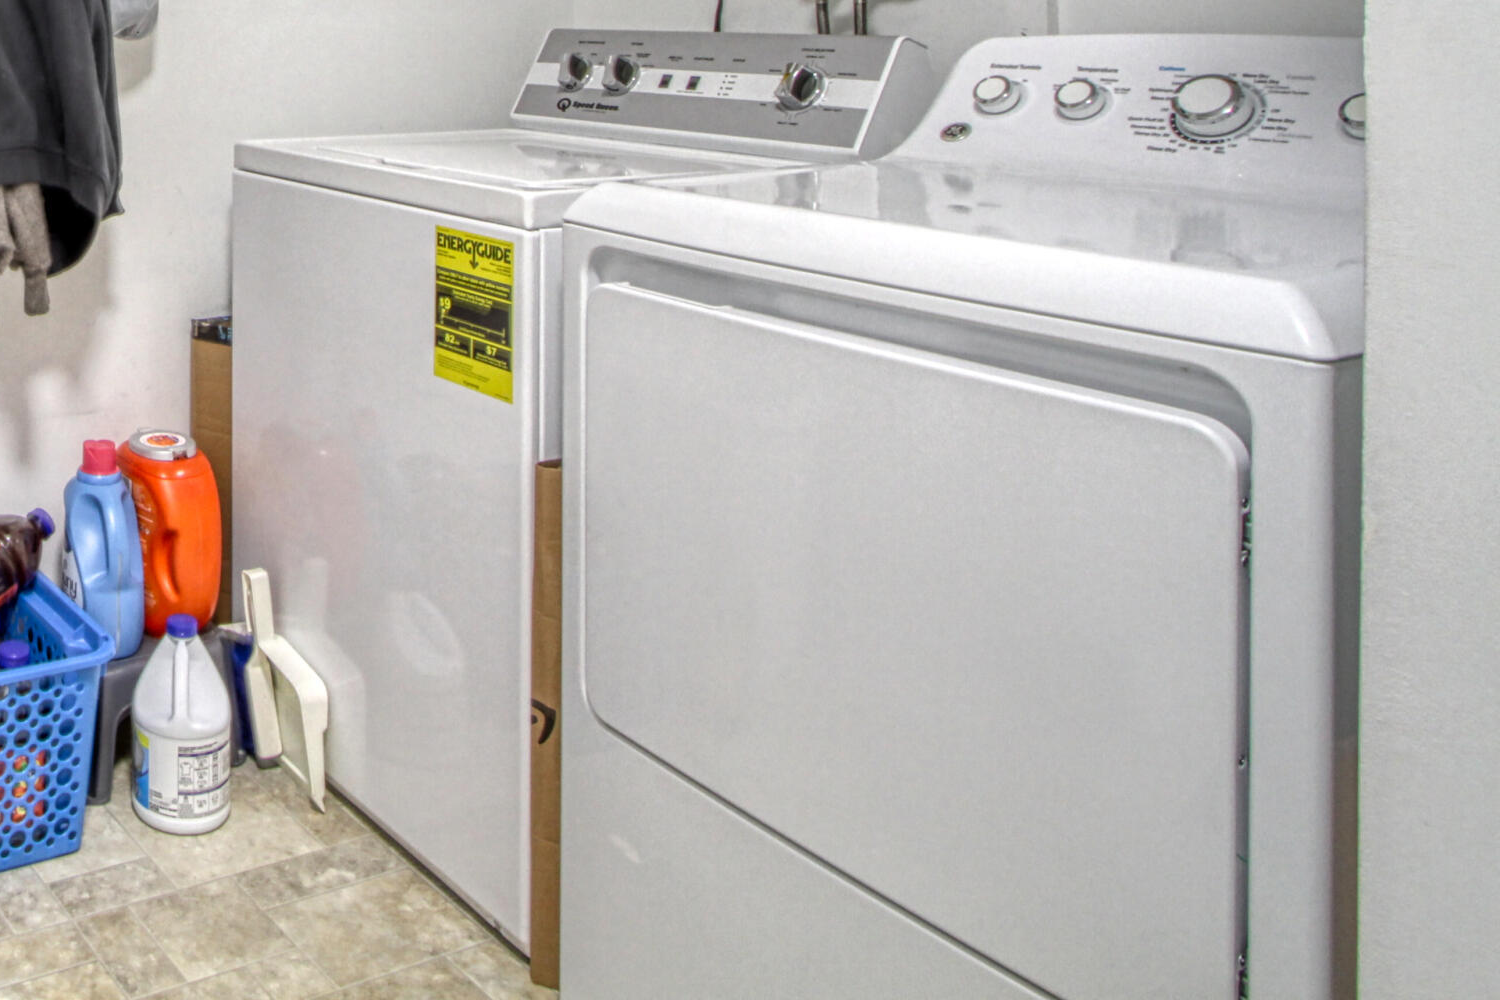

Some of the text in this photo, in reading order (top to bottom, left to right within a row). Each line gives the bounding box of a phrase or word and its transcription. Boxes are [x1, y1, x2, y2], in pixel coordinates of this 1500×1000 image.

[1077, 66, 1119, 74] Temperature
[572, 101, 595, 109] Speed
[437, 232, 512, 265] ENERGYGUIDE
